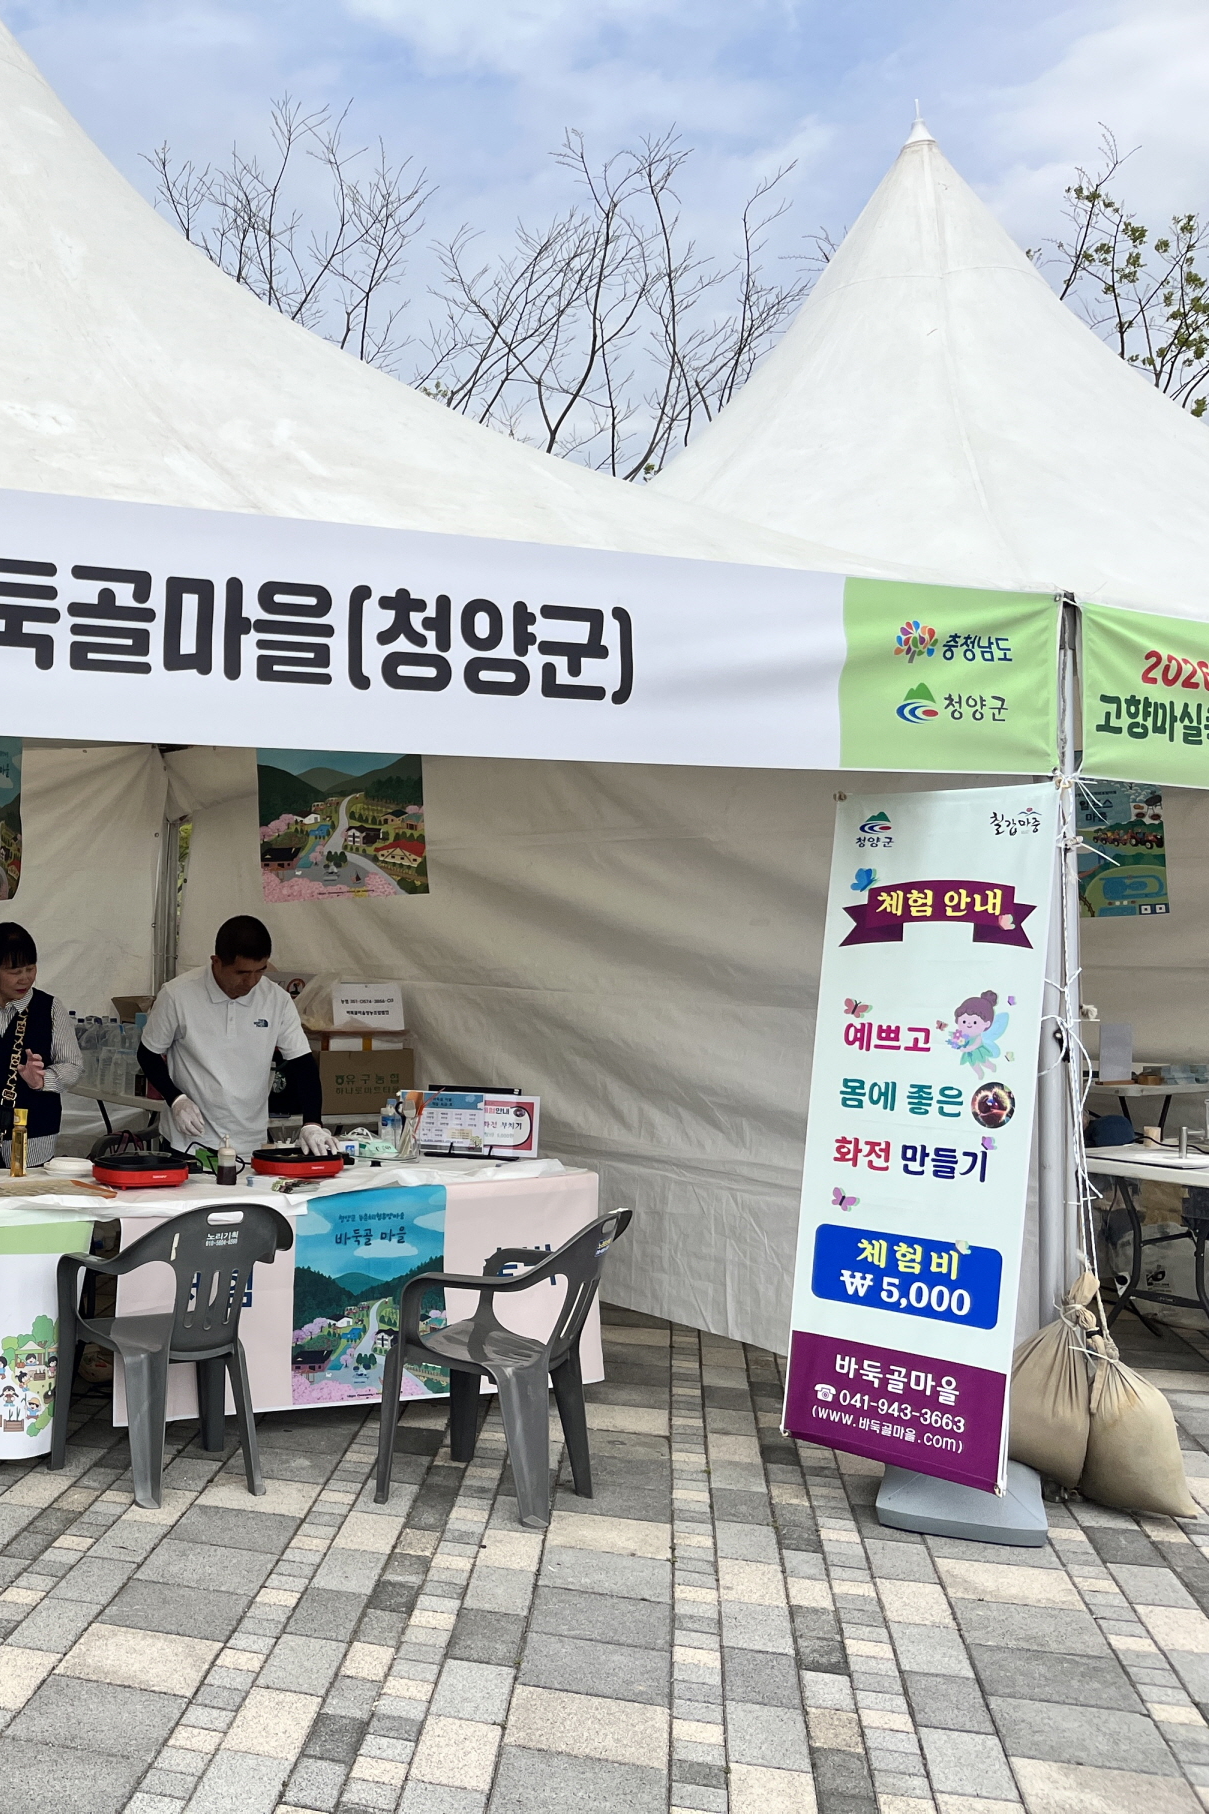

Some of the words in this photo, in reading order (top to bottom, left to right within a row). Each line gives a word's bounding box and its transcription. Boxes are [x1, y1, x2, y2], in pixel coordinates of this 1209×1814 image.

[942, 633, 1013, 662] 충청남도
[944, 693, 1008, 722] 청양군
[1096, 694, 1209, 746] 고향마실
[989, 811, 1041, 836] 칠갑마중
[855, 836, 894, 848] 청양군
[875, 889, 934, 917] 체험
[943, 888, 1003, 917] 안내
[843, 1022, 931, 1052] 예쁘고
[839, 1078, 897, 1112] 몸에
[906, 1083, 964, 1118] 좋은
[833, 1136, 892, 1172] 화전
[901, 1144, 988, 1183] 만들기
[335, 1228, 373, 1246] 바둑골
[380, 1225, 407, 1244] 마을
[856, 1238, 960, 1281] 체험비
[880, 1276, 971, 1316] 5,000
[835, 1354, 960, 1406] 바둑골마을
[839, 1389, 966, 1433] 041-943-3663
